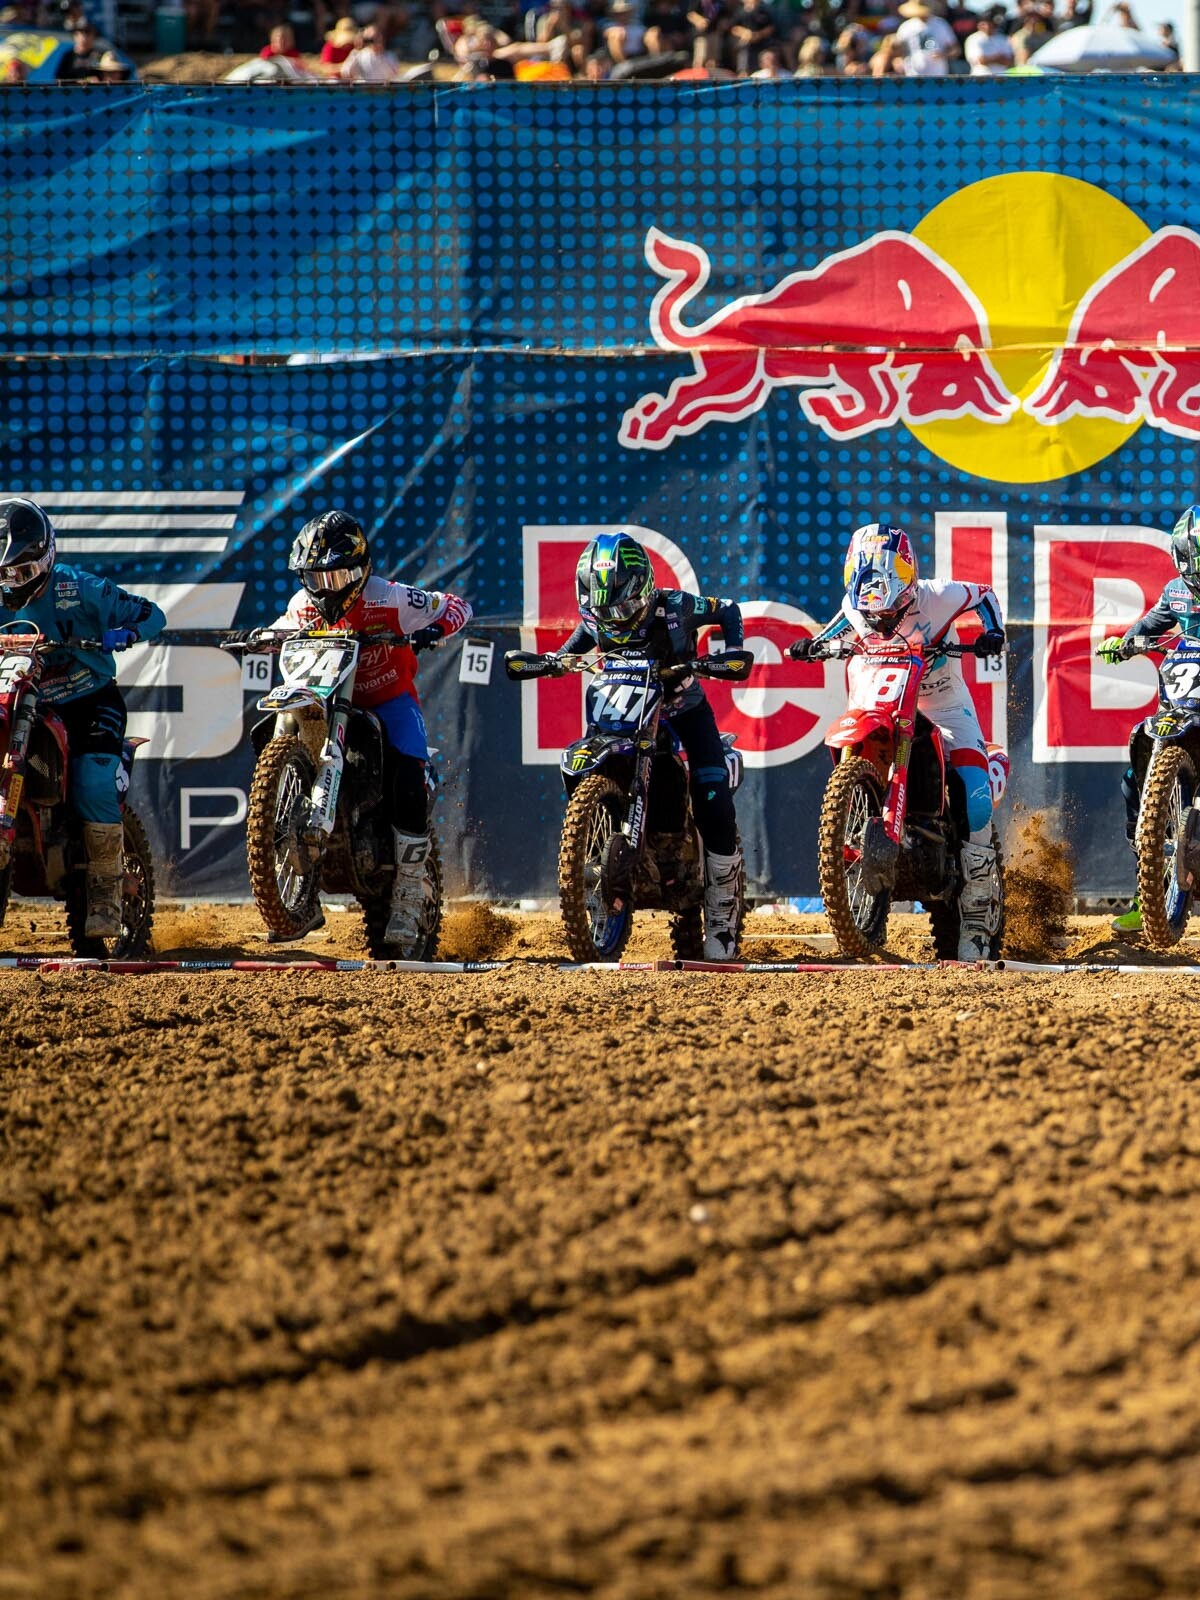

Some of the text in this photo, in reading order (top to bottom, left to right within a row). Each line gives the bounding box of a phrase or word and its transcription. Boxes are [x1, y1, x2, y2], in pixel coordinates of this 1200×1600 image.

[360, 647, 381, 665] FLY
[466, 653, 488, 673] 15
[983, 655, 1003, 672] 13
[246, 660, 268, 680] 16
[286, 650, 342, 688] 24
[354, 668, 398, 693] qvarna
[609, 673, 643, 682] LUCAS OIL
[592, 684, 656, 722] 147
[319, 768, 334, 816] DUNLOP
[630, 796, 644, 848] DUNLOP
[893, 782, 906, 837] DUNLOP
